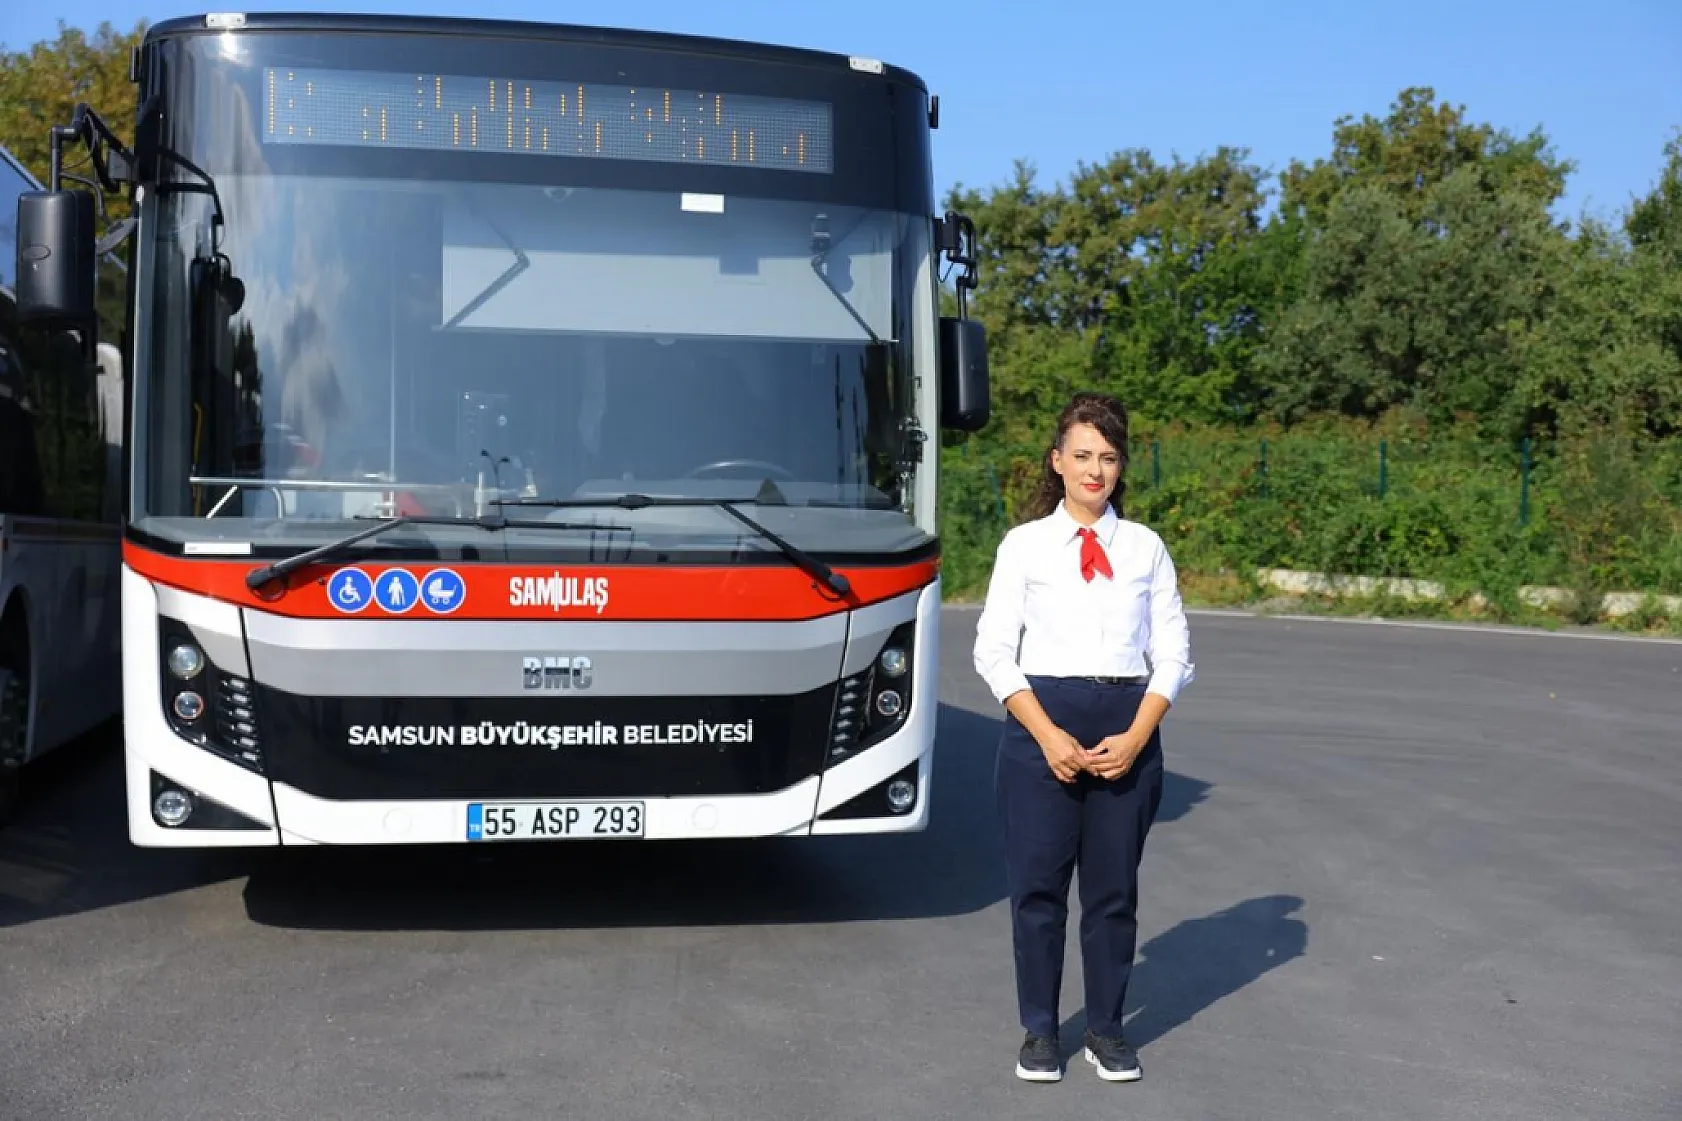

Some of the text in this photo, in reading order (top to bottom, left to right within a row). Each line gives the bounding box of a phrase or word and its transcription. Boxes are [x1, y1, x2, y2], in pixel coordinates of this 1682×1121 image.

[523, 656, 593, 690] BMC
[348, 719, 753, 750] SAMSUN BÜYÜKŞEHİR BELEDİYESİ
[485, 806, 640, 835] 55 ASP 293
